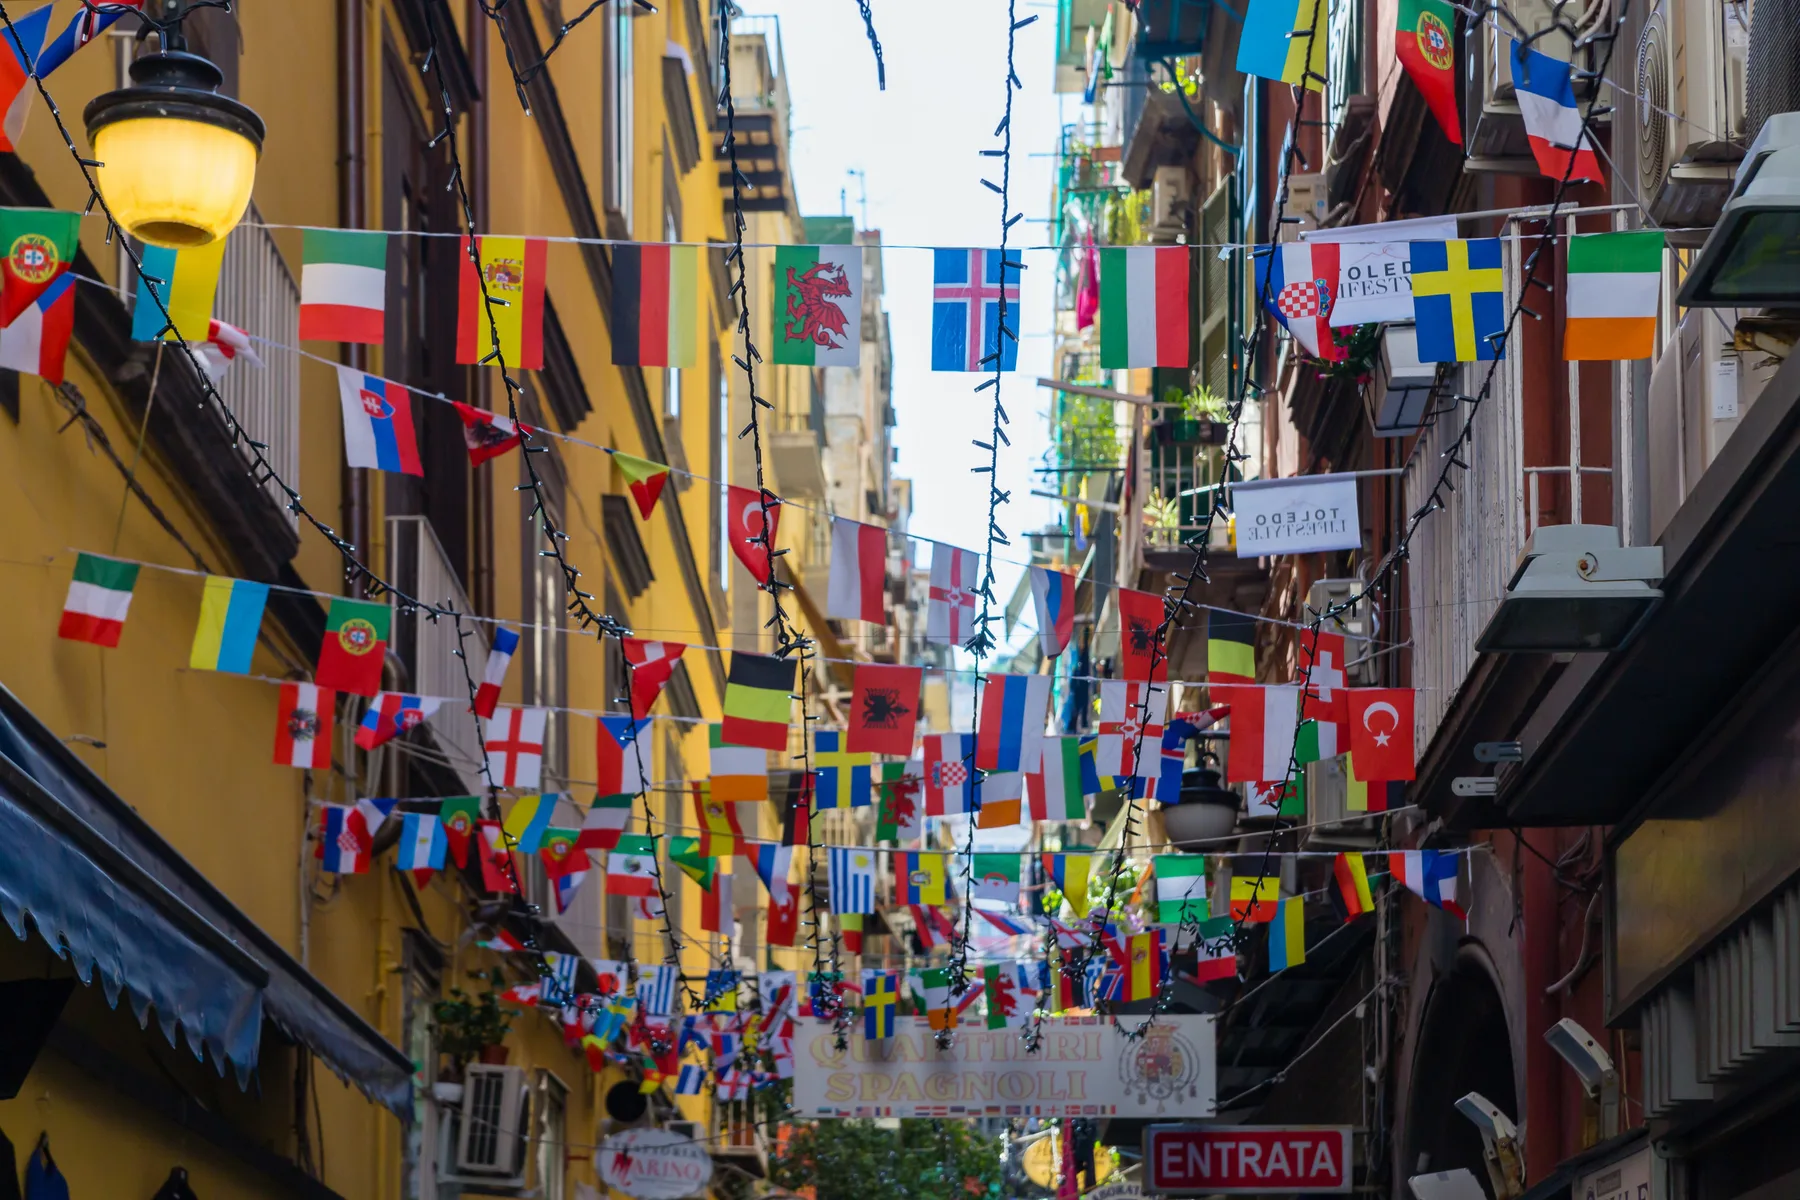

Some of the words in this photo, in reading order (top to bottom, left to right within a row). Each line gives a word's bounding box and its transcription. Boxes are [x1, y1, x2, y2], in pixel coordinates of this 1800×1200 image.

[1339, 260, 1412, 280] OLED
[1337, 276, 1413, 299] IFESTY
[809, 1031, 1103, 1070] QUARTIERI
[824, 1070, 1088, 1102] SPAGNOLI
[610, 1151, 702, 1187] MARINO
[1161, 1140, 1338, 1179] ENTRATA
